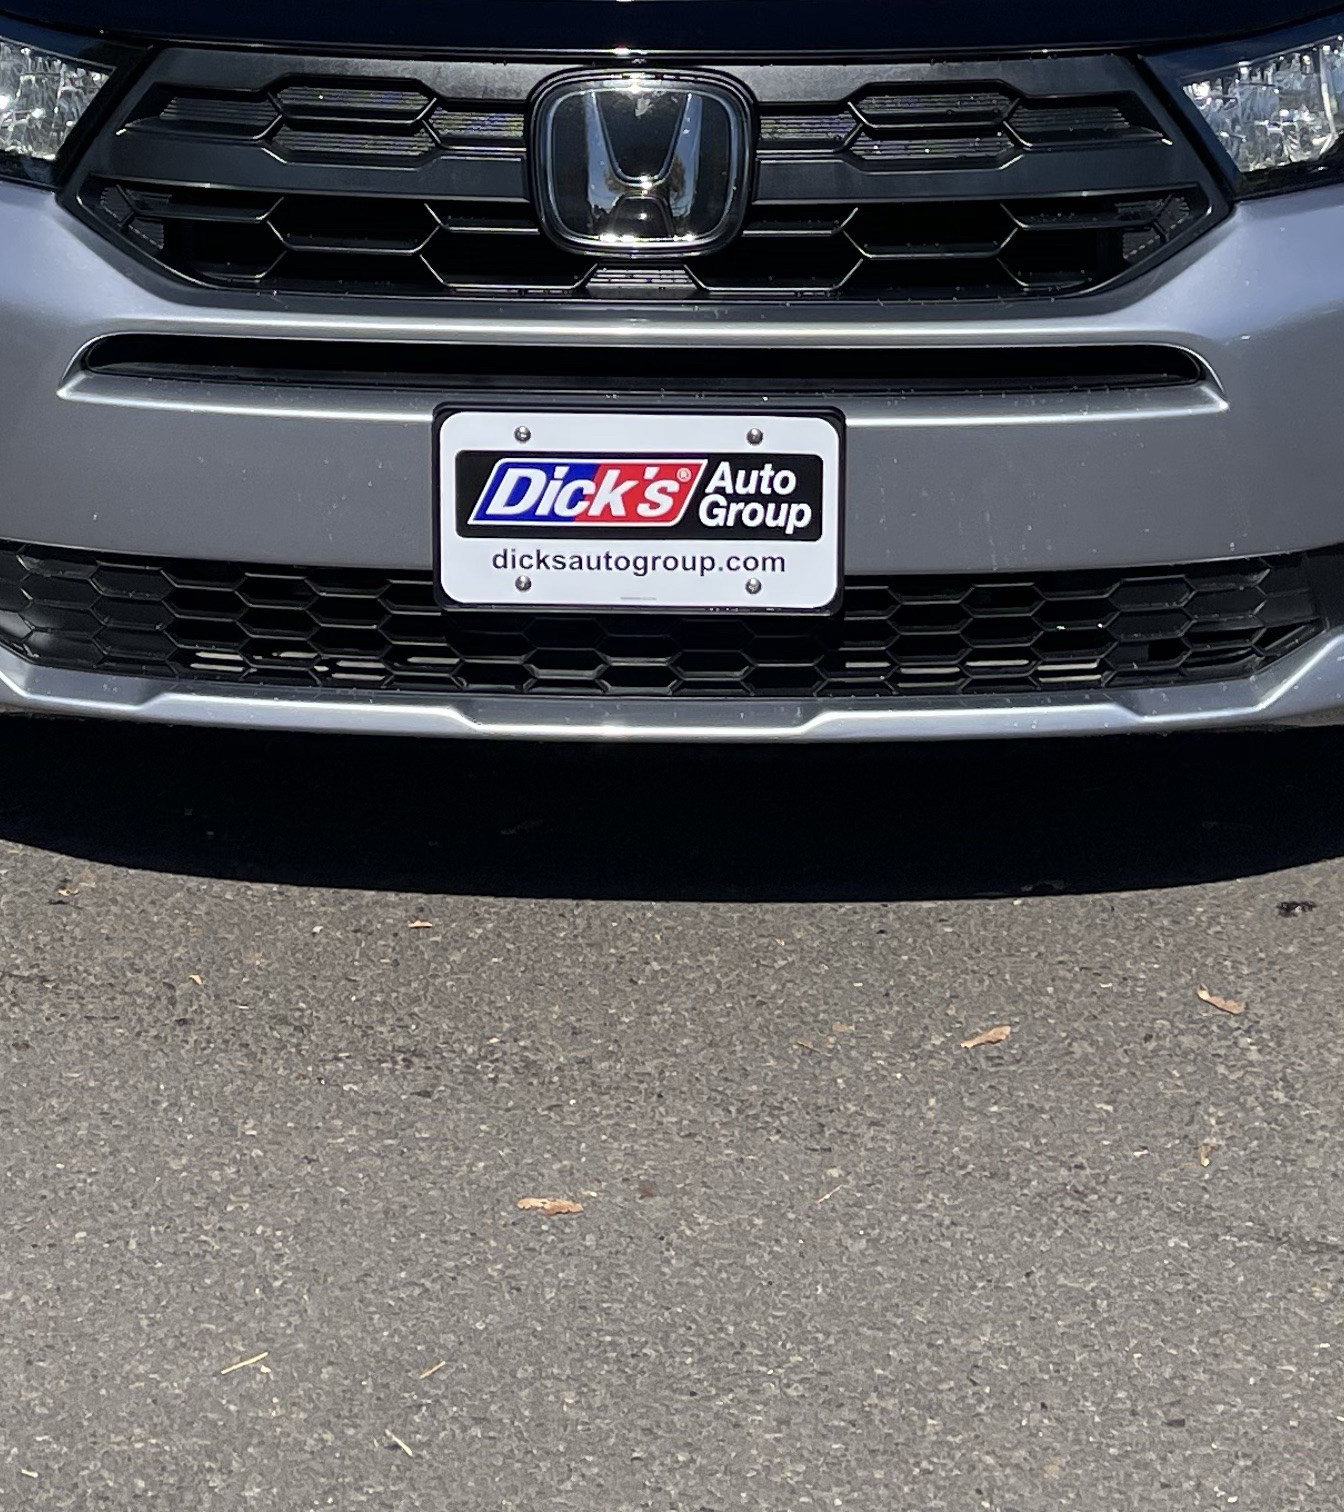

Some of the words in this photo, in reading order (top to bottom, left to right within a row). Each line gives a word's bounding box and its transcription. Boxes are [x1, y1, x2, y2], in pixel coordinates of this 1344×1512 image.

[704, 461, 797, 495] Auto
[698, 494, 812, 534] Group
[492, 549, 786, 576] dicksautogroup.com
